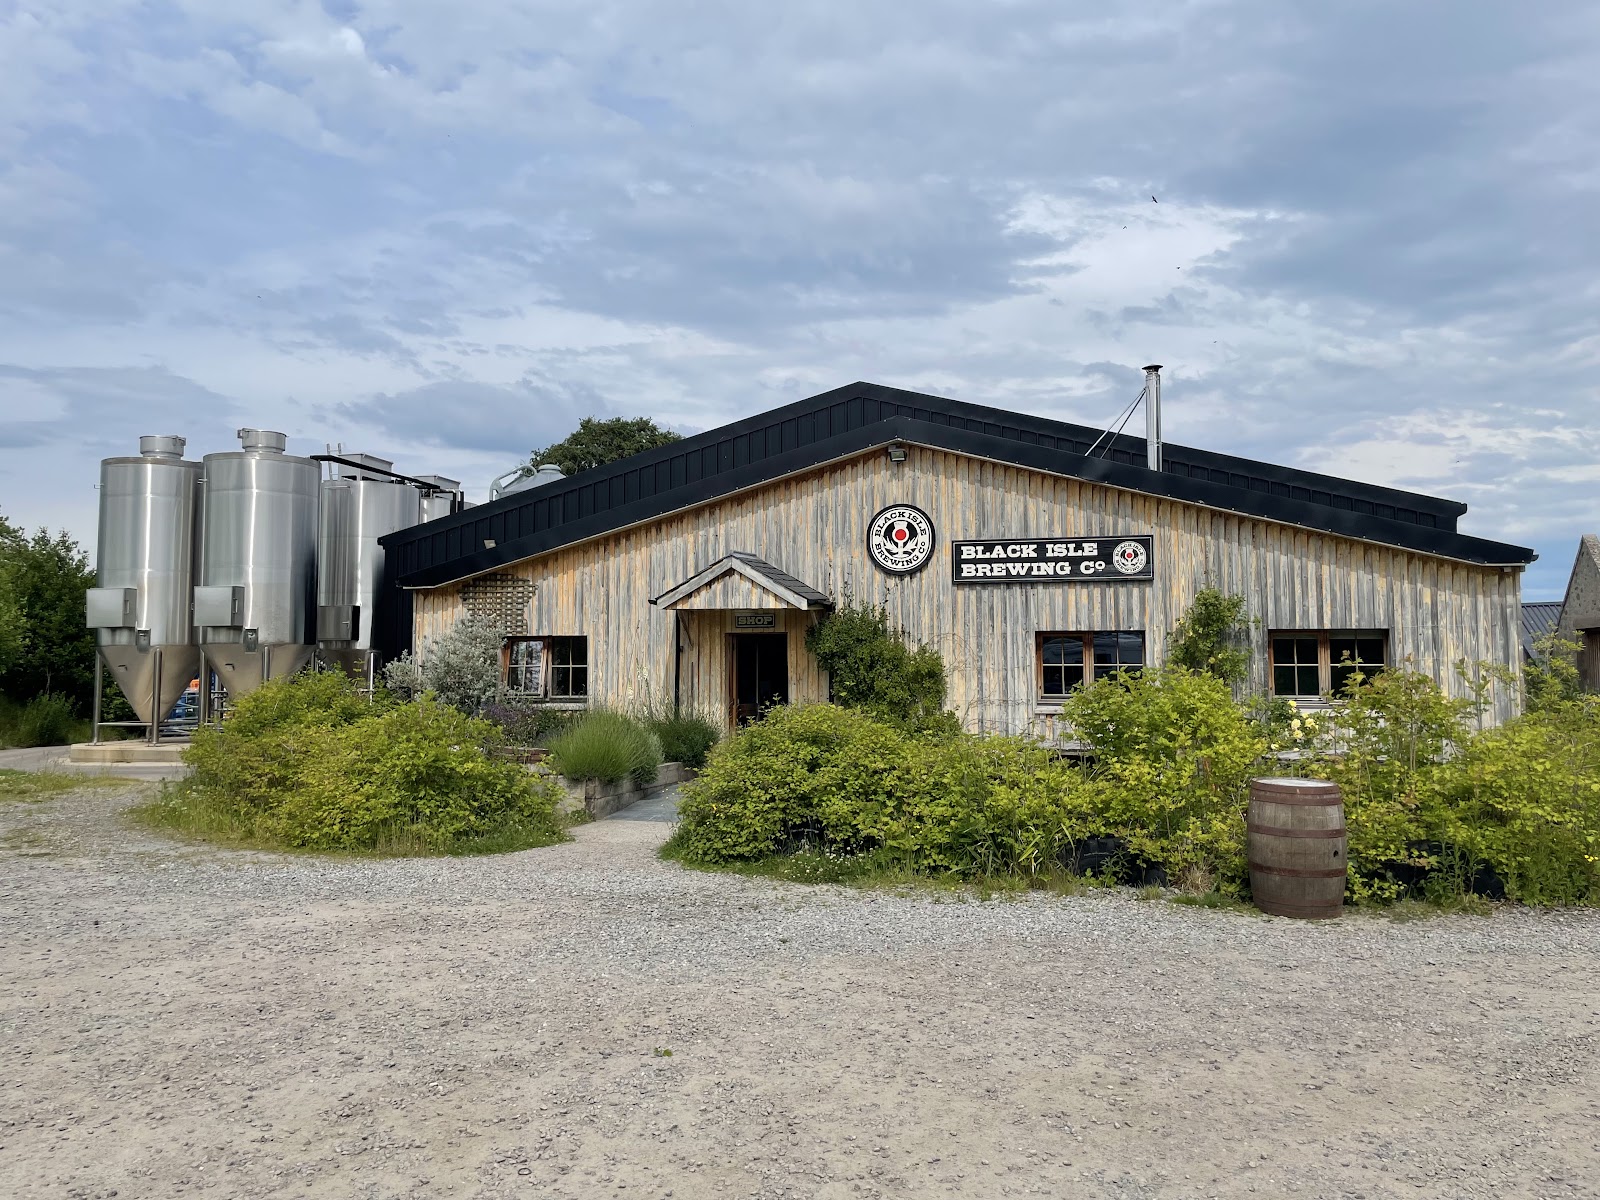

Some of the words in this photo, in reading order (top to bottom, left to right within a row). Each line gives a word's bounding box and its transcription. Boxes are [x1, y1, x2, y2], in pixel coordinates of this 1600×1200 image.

[874, 511, 906, 537] BLACK
[907, 512, 927, 536] ISLE
[874, 543, 919, 566] BREWING
[961, 544, 1037, 559] BLACK
[1046, 542, 1098, 557] ISLE
[961, 561, 1072, 577] BREWING
[738, 616, 772, 625] SHOP
